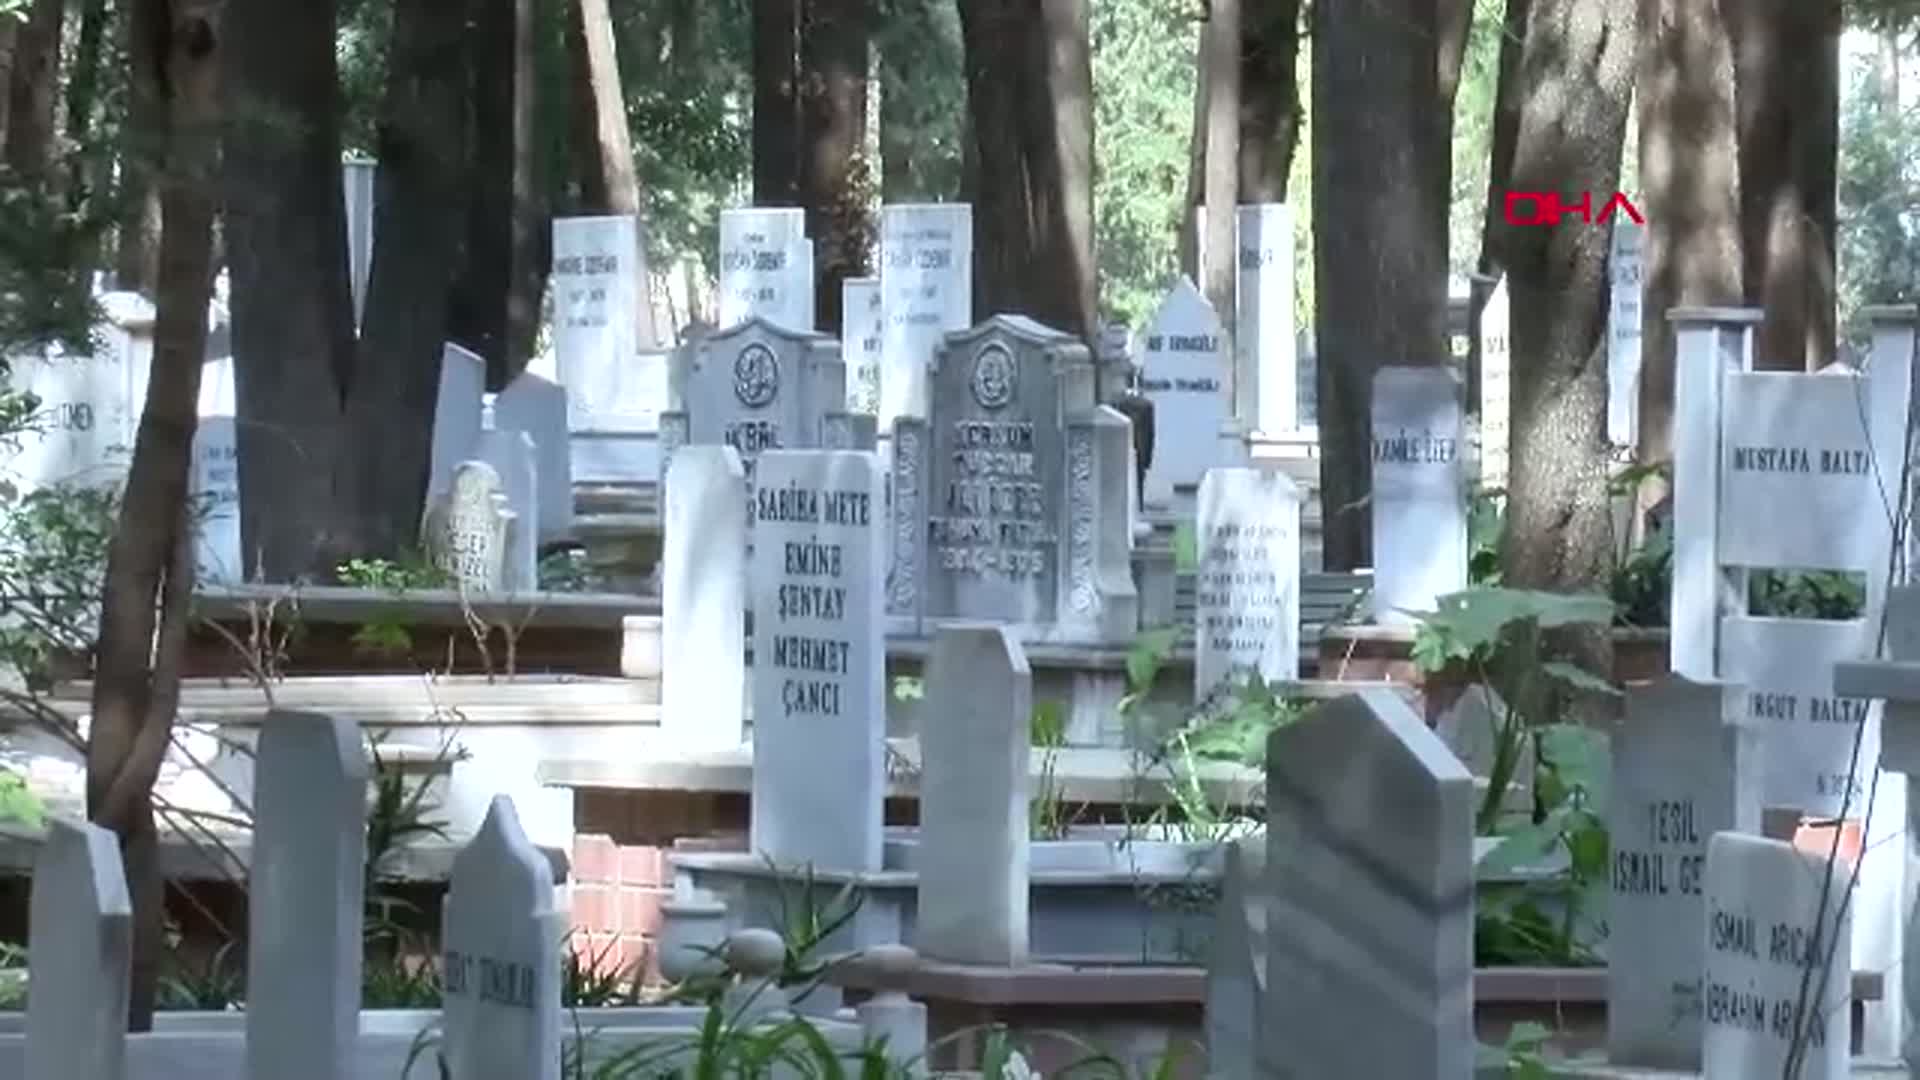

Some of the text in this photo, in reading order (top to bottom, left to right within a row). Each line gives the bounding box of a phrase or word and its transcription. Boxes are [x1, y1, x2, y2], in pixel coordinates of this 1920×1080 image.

[1735, 448, 1810, 472] MUSTAFA
[758, 479, 818, 523] SABİHA
[824, 490, 870, 526] METE
[785, 534, 841, 577] EMİNE
[778, 584, 847, 621] ŞENTAY
[774, 634, 850, 674] MEHMET
[782, 678, 839, 717] ÇANCI
